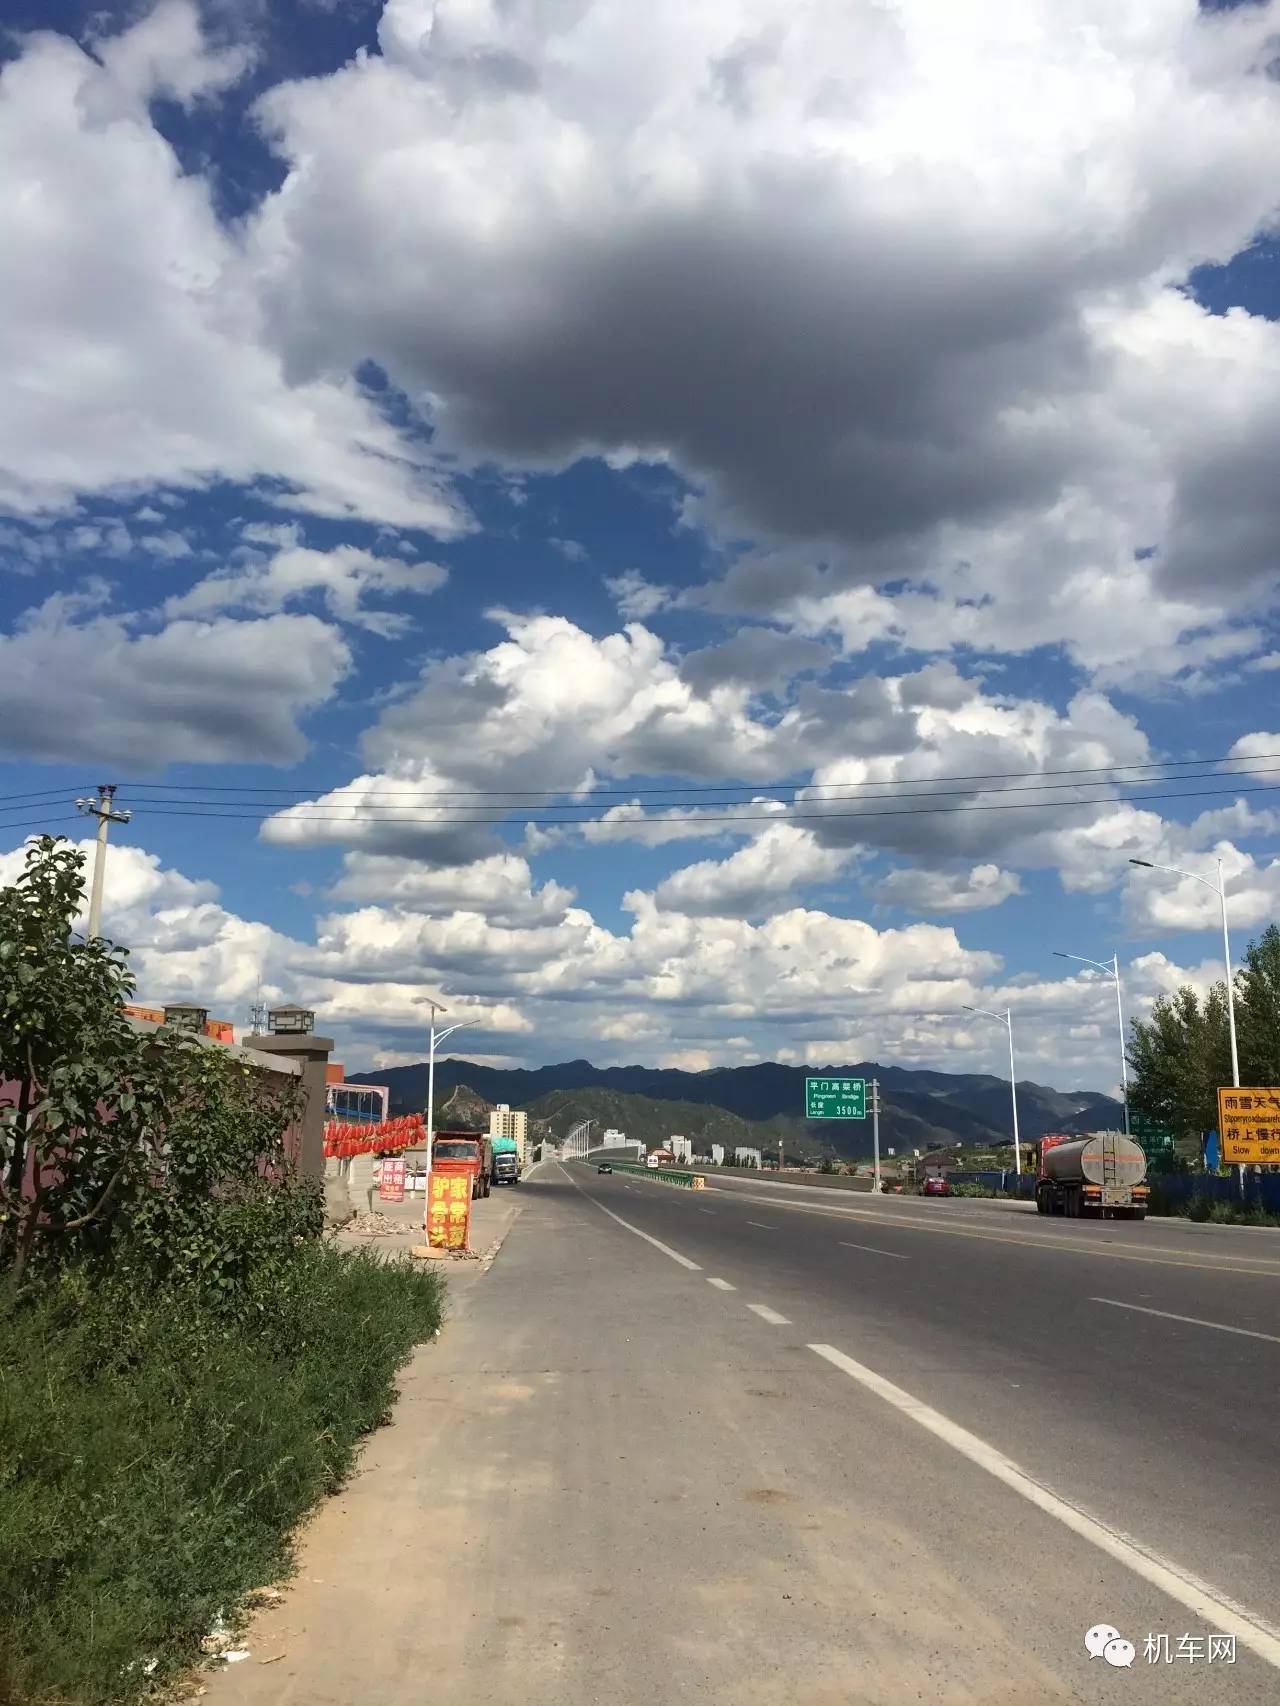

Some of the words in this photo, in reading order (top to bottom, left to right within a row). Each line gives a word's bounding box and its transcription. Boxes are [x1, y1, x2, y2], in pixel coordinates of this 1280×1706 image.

[1224, 1096, 1280, 1110] 雨雪天气
[1227, 1127, 1280, 1141] 桥上慢行
[1232, 1145, 1250, 1155] Slow
